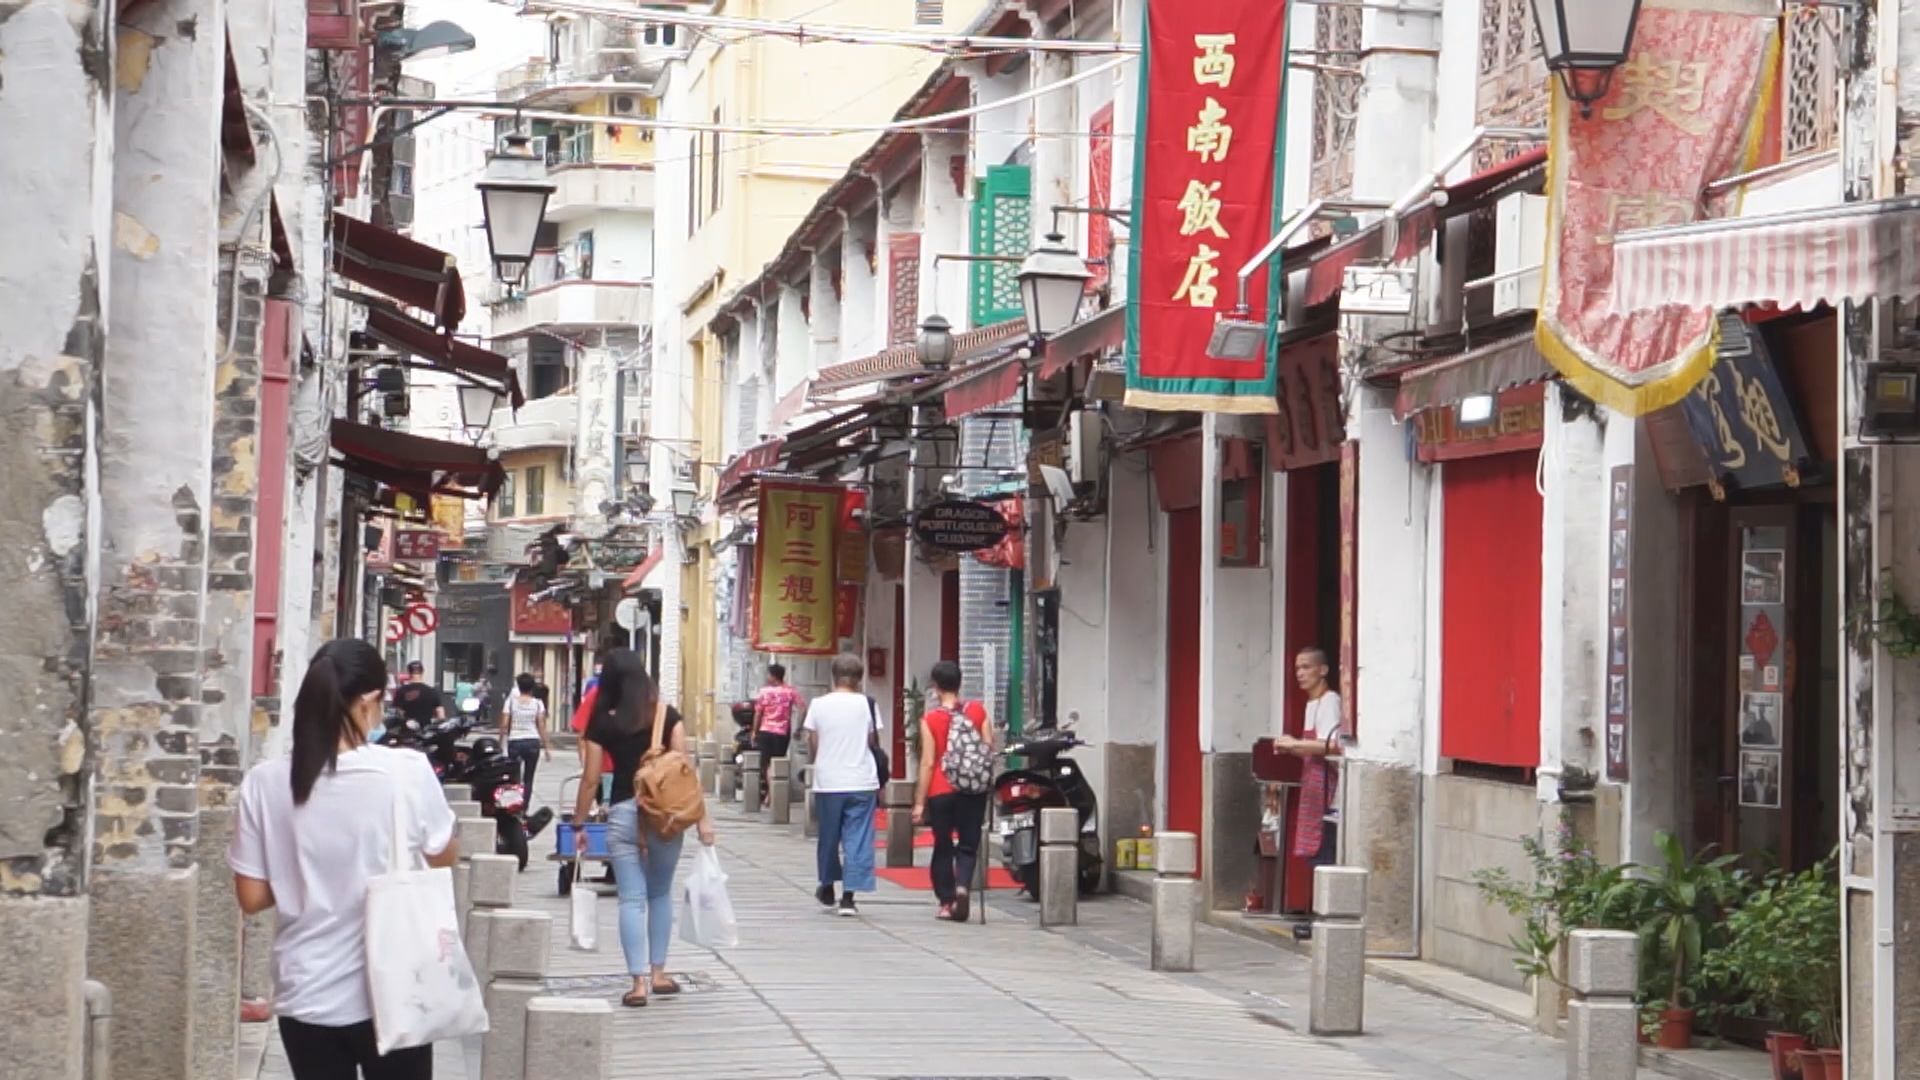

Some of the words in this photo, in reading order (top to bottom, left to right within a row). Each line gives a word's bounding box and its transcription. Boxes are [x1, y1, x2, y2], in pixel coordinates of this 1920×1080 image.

[1172, 32, 1237, 308] 西南飯店
[776, 502, 823, 643] 阿三靚翅
[935, 508, 990, 520] DRAGON
